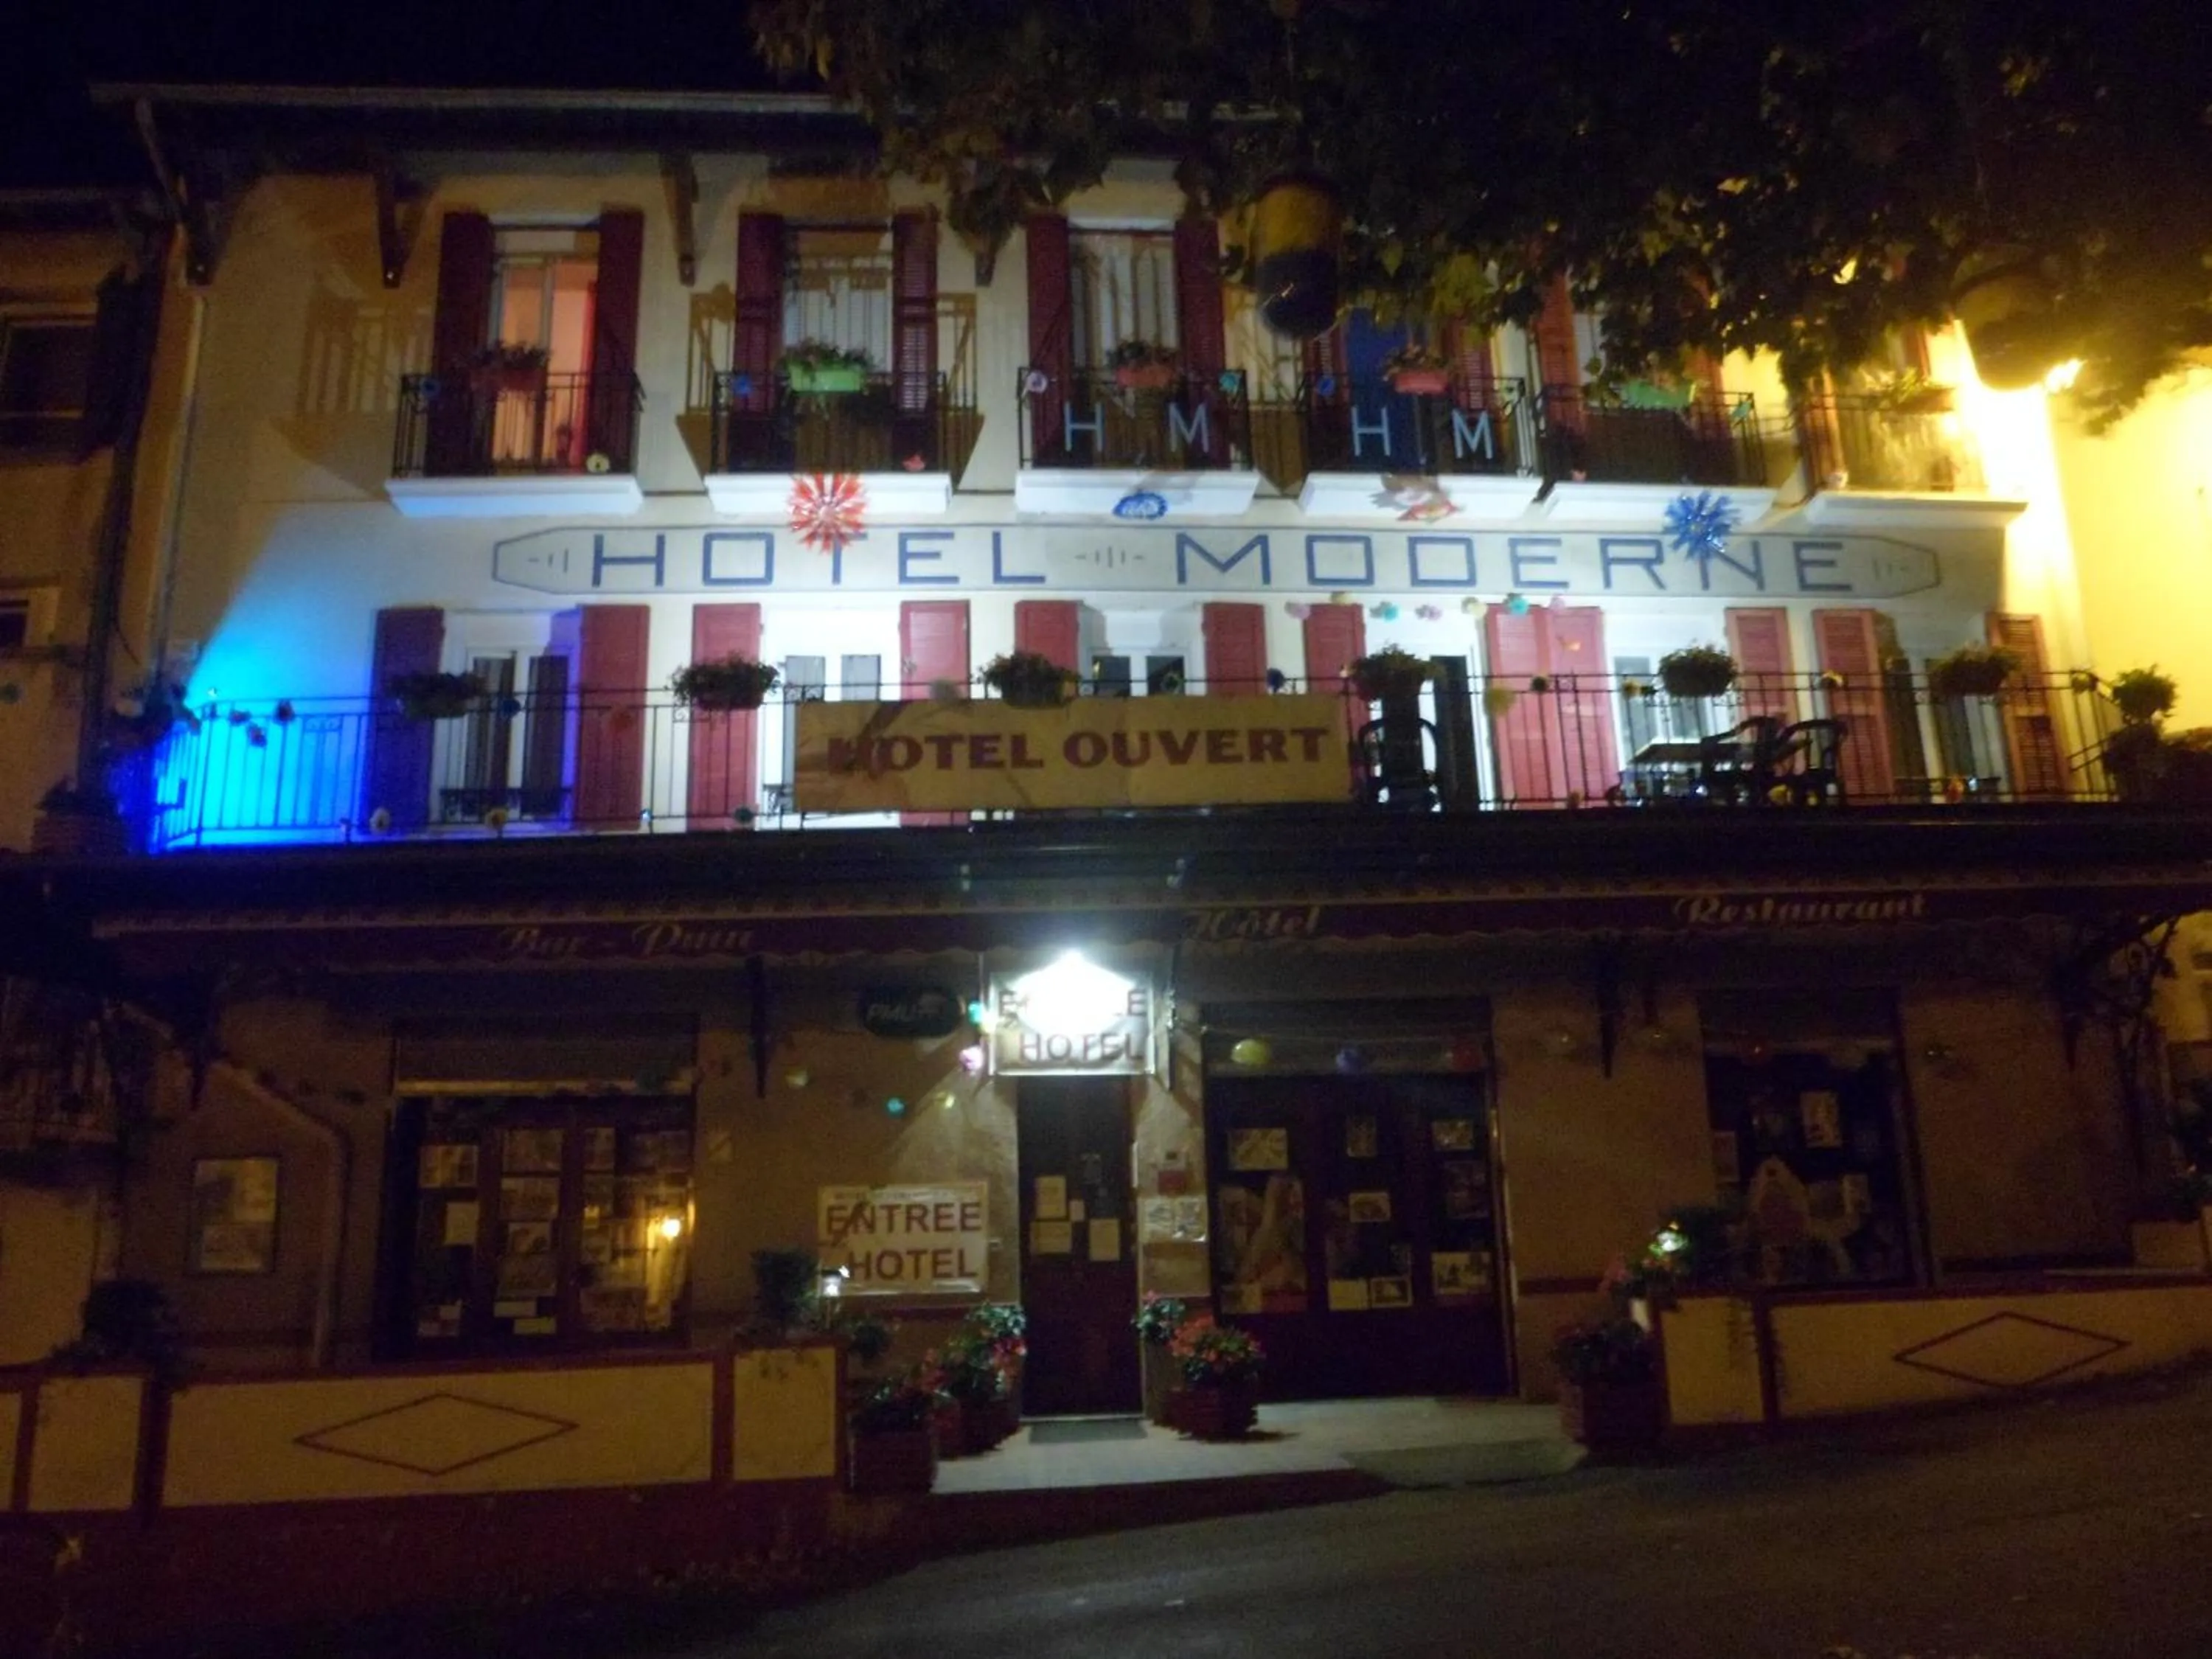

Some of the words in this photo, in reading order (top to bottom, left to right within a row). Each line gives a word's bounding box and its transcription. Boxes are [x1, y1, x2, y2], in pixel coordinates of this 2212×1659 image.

[1063, 400, 1105, 452] H
[1167, 403, 1210, 453] M
[1350, 405, 1391, 456] H
[1451, 408, 1494, 460] M
[591, 529, 1047, 587] HOTEL
[1175, 532, 1853, 591] MODERNE
[826, 732, 1045, 776] HOTEL
[1062, 726, 1329, 769] OUVERT
[1020, 1032, 1144, 1062] HOTEL
[826, 1200, 983, 1236] ENTREE
[849, 1247, 979, 1281] HOTEL
